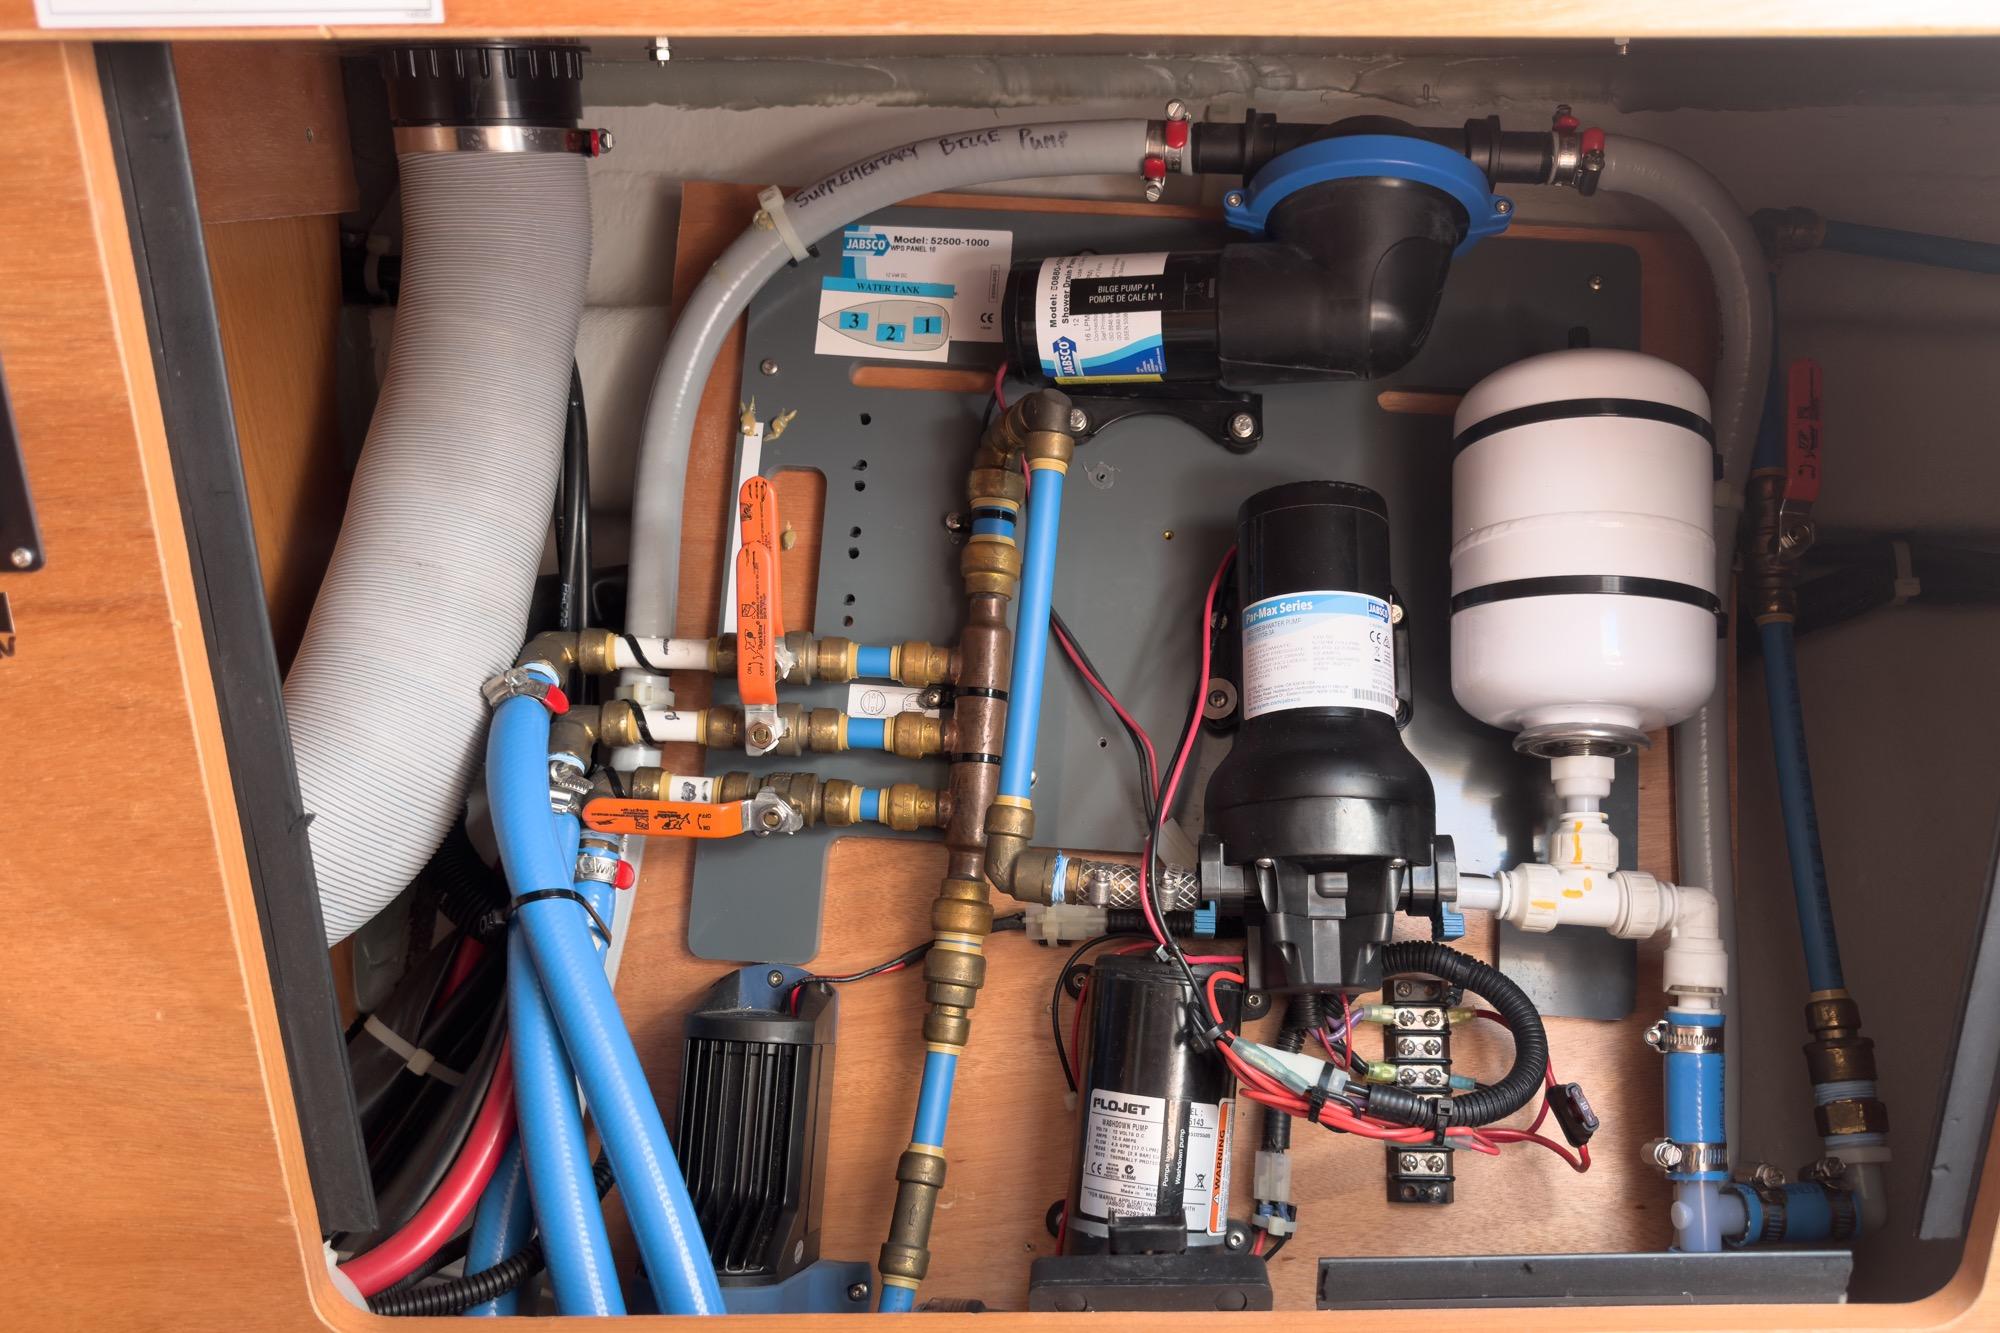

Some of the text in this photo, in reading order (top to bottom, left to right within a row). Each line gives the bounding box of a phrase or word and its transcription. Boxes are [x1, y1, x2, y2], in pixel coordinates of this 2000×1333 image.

[793, 142, 920, 208] SUPPLEMENTARY
[938, 127, 1001, 155] BILGE
[846, 238, 886, 251] JABSCO
[894, 235, 990, 247] Model: 52500-1000
[856, 282, 920, 295] WATER TANK
[1098, 283, 1119, 293] BILGE
[1120, 282, 1143, 292] PUMP
[1089, 294, 1115, 303] POMPE
[1116, 294, 1126, 302] DE
[1128, 293, 1146, 301] CALE
[1159, 292, 1163, 300] 1
[1062, 290, 1070, 324] Shower
[849, 313, 859, 329] 3
[924, 318, 931, 333] 1
[885, 326, 896, 341] 2
[1059, 341, 1075, 375] JABSCO
[1246, 599, 1313, 625] Par-Max Series
[1093, 1097, 1150, 1116] FLOJET
[1581, 1101, 1588, 1110] 10
[1131, 1122, 1149, 1132] PUMP
[1174, 1128, 1186, 1185] Washdown pump
[1215, 1130, 1226, 1190] WARNING
